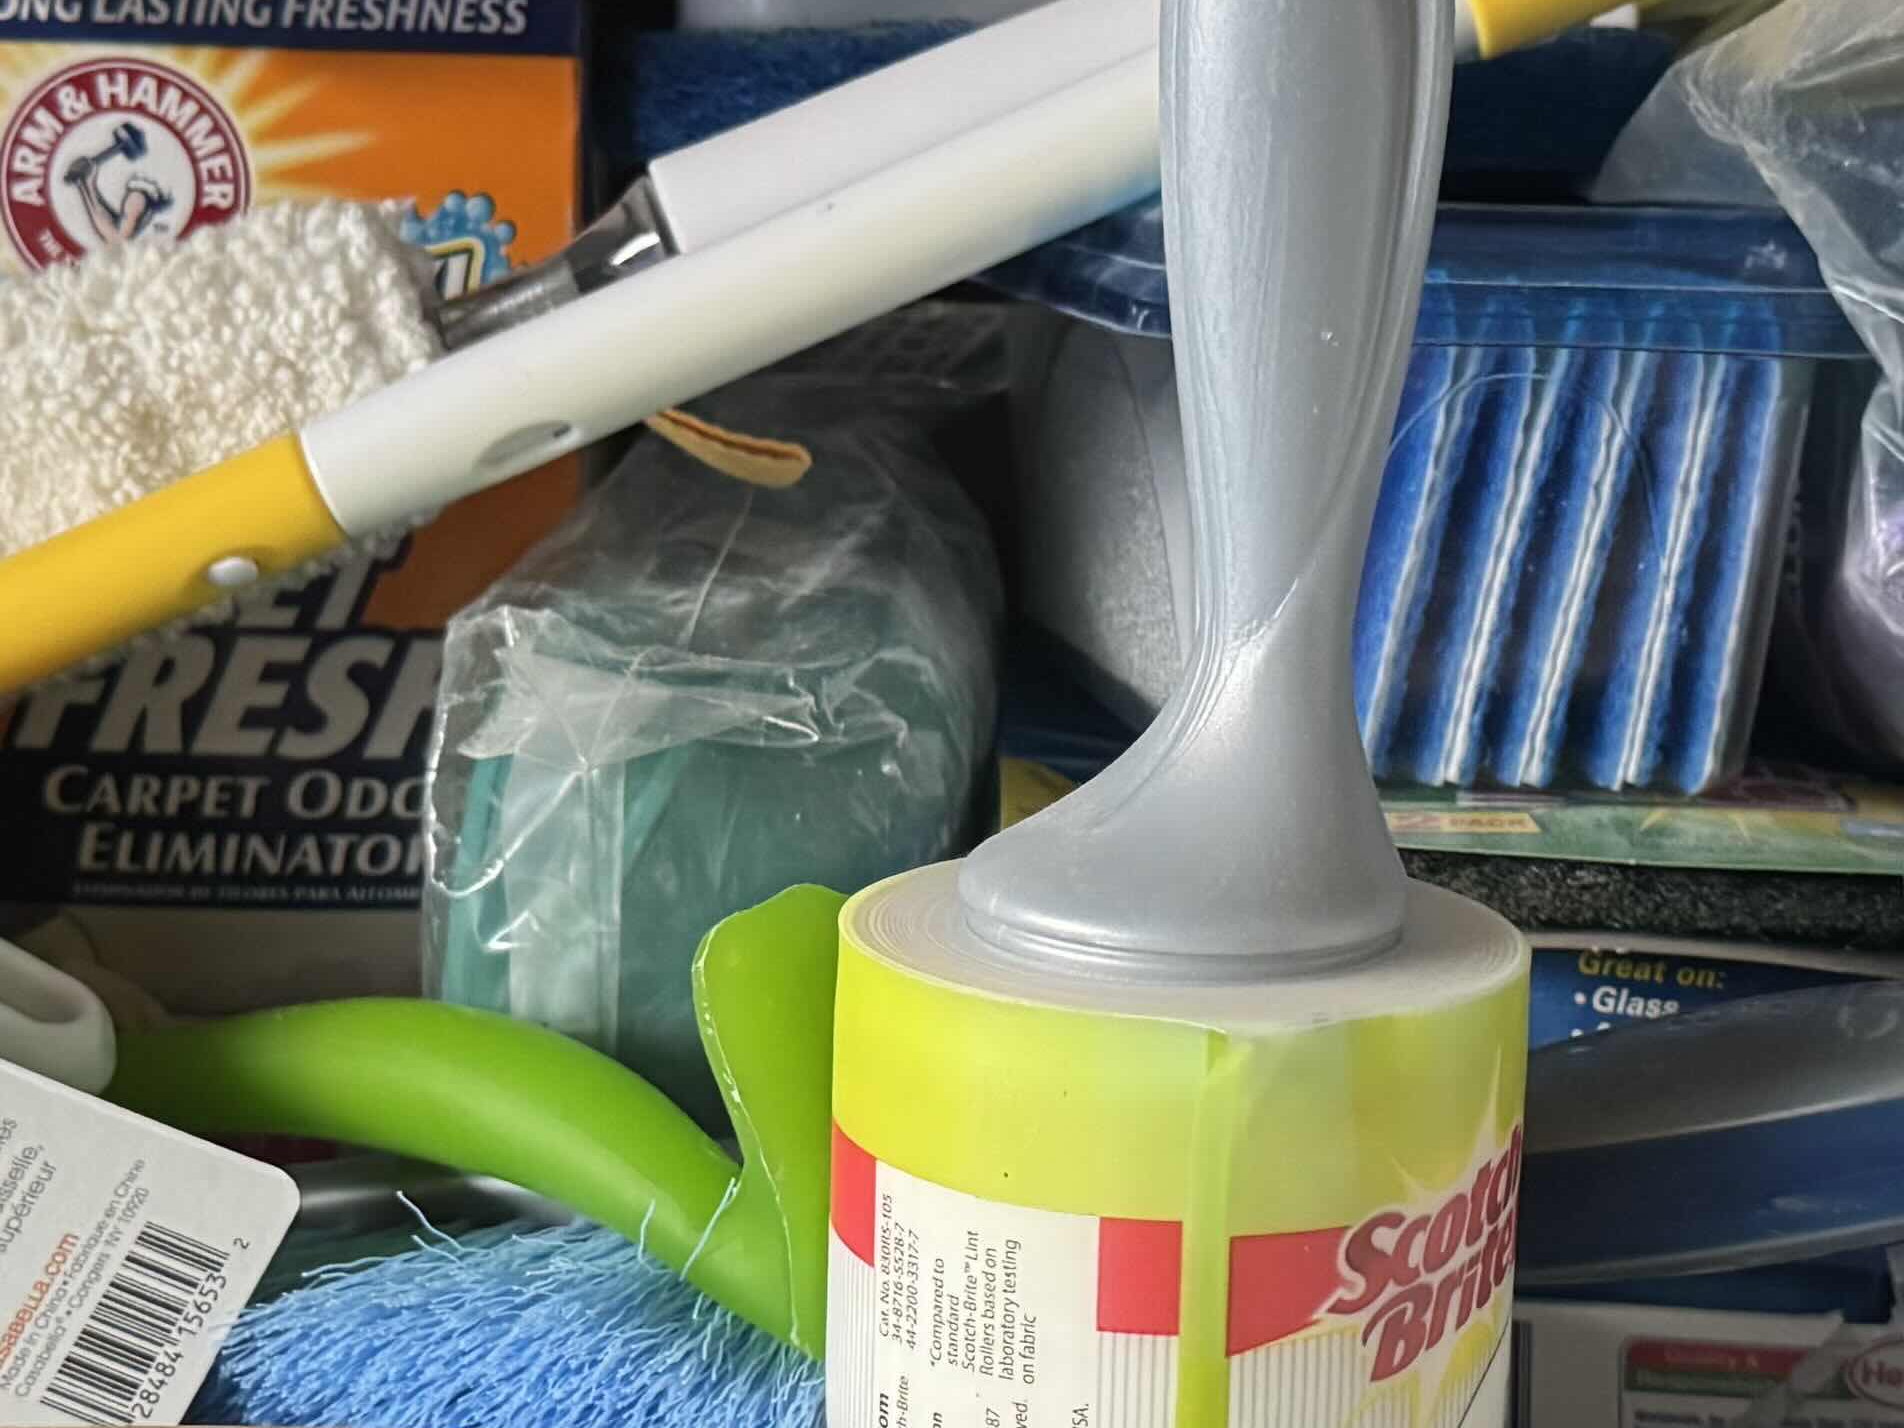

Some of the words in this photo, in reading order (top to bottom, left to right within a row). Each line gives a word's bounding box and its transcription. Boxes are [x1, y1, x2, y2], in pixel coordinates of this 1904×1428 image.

[12, 104, 64, 205] ARM
[57, 85, 95, 121] &
[95, 72, 236, 210] HAMMER
[289, 772, 426, 820] ODO
[1578, 950, 1664, 983] Great
[1677, 962, 1724, 989] on:
[934, 1259, 944, 1274] to
[965, 1231, 978, 1260] Lint
[985, 1248, 996, 1268] on
[1002, 1240, 1021, 1293] testing
[981, 1271, 996, 1319] based
[135, 1350, 184, 1419] 28484
[180, 1265, 227, 1336] 15653
[233, 1238, 249, 1249] 2
[947, 1294, 959, 1366] standard
[979, 1324, 994, 1376] Rollers
[998, 1298, 1020, 1380] laboratory
[1019, 1314, 1036, 1359] fabric
[1023, 1364, 1034, 1384] on
